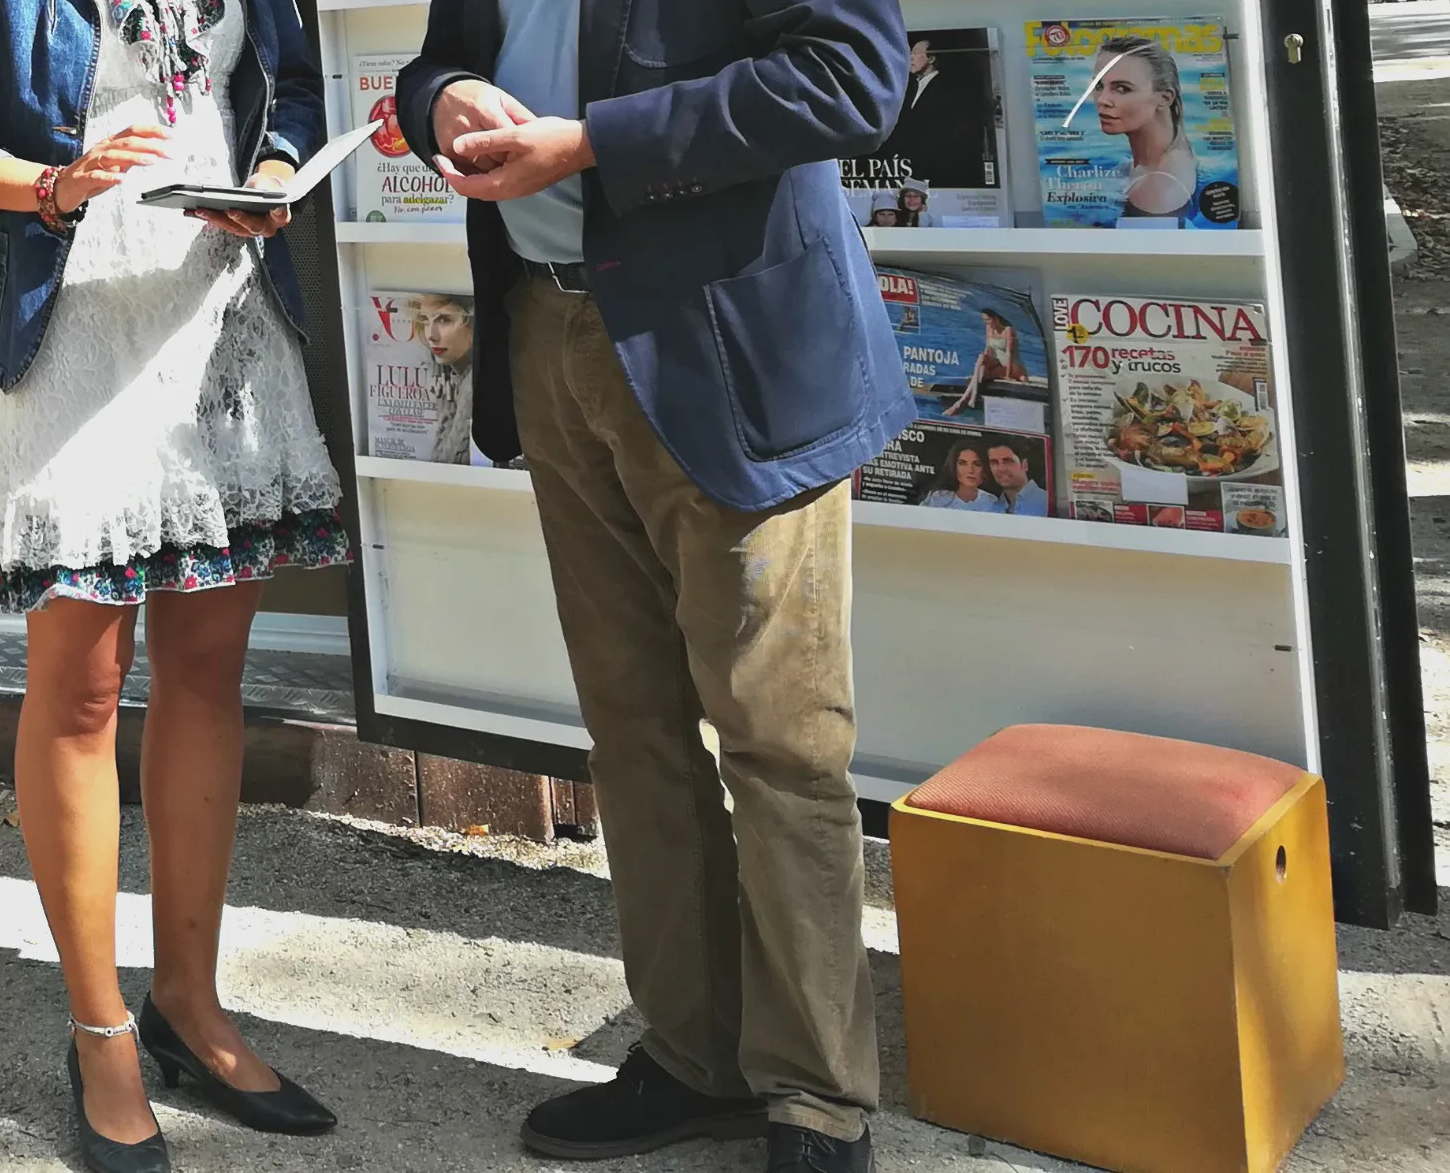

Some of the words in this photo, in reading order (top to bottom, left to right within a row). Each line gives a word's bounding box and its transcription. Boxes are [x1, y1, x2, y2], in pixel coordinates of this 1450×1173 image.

[360, 76, 394, 91] BUE
[376, 162, 400, 175] ¿Hay
[402, 163, 420, 174] que
[839, 159, 865, 178] EL
[869, 154, 914, 178] PAÍS
[381, 175, 455, 193] ALCOHOL
[381, 196, 402, 207] para
[402, 194, 455, 208] adelgazar?
[1047, 191, 1108, 206] Explosiva
[878, 274, 915, 295] OLA!
[1052, 298, 1069, 332] LOVE
[1070, 298, 1267, 343] COCINA
[903, 346, 960, 366] PANTOJA
[1062, 346, 1109, 368] 170
[1111, 347, 1176, 361] recetas
[903, 362, 936, 376] RADAS
[1111, 360, 1123, 374] y
[1128, 359, 1182, 374] trucos
[376, 361, 429, 389] LULÚ
[910, 376, 924, 387] DE
[370, 384, 431, 402] FIGUEROA
[898, 429, 925, 443] SCO
[881, 451, 921, 463] TREVISTA
[862, 466, 874, 475] SU
[874, 467, 912, 480] RETIRADA
[880, 459, 914, 472] EMOTIVA
[915, 465, 936, 475] ANTE
